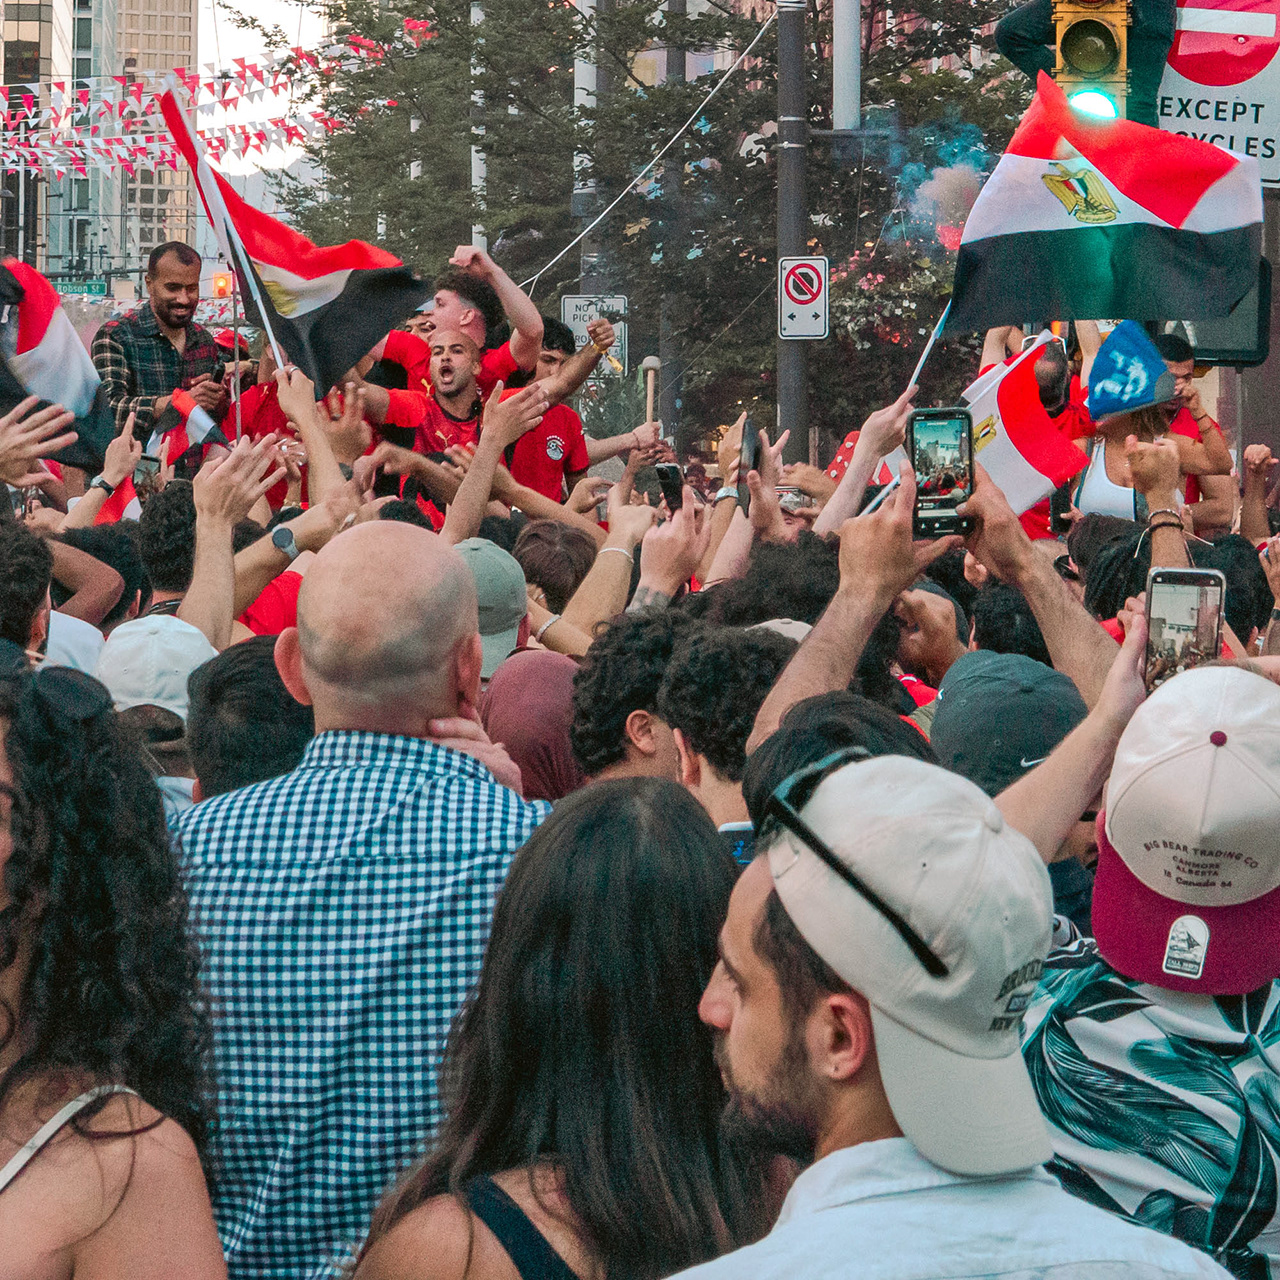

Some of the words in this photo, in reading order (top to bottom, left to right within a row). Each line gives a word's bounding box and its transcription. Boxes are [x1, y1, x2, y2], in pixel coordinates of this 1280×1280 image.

[1160, 96, 1265, 124] EXCEPT
[57, 284, 88, 293] Robson
[91, 284, 100, 293] St
[575, 304, 588, 312] NO
[573, 314, 593, 322] PICK
[1144, 840, 1159, 852] BIG
[1162, 840, 1188, 853] BEAR
[1192, 847, 1243, 861] TRADING
[1244, 856, 1259, 869] CO
[1172, 855, 1220, 869] CANMORE
[1176, 865, 1219, 876] ALBERTA
[1175, 876, 1216, 887] Canada
